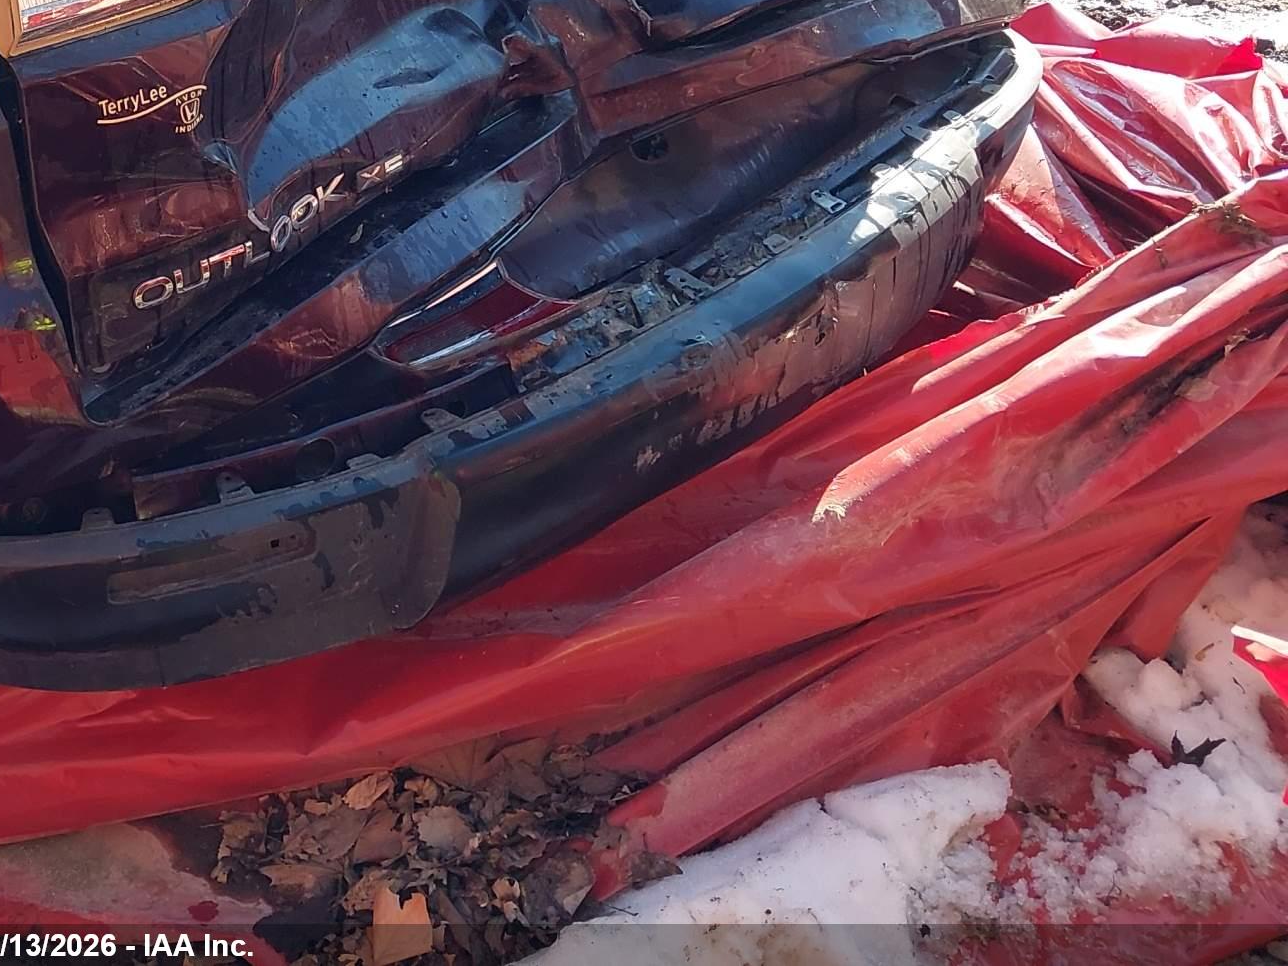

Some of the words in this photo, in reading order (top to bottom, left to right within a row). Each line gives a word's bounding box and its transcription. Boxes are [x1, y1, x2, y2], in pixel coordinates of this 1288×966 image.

[98, 84, 168, 117] TerryLee
[175, 89, 203, 106] AVON
[175, 113, 204, 133] INDIANA
[132, 172, 348, 310] OUTLOOK
